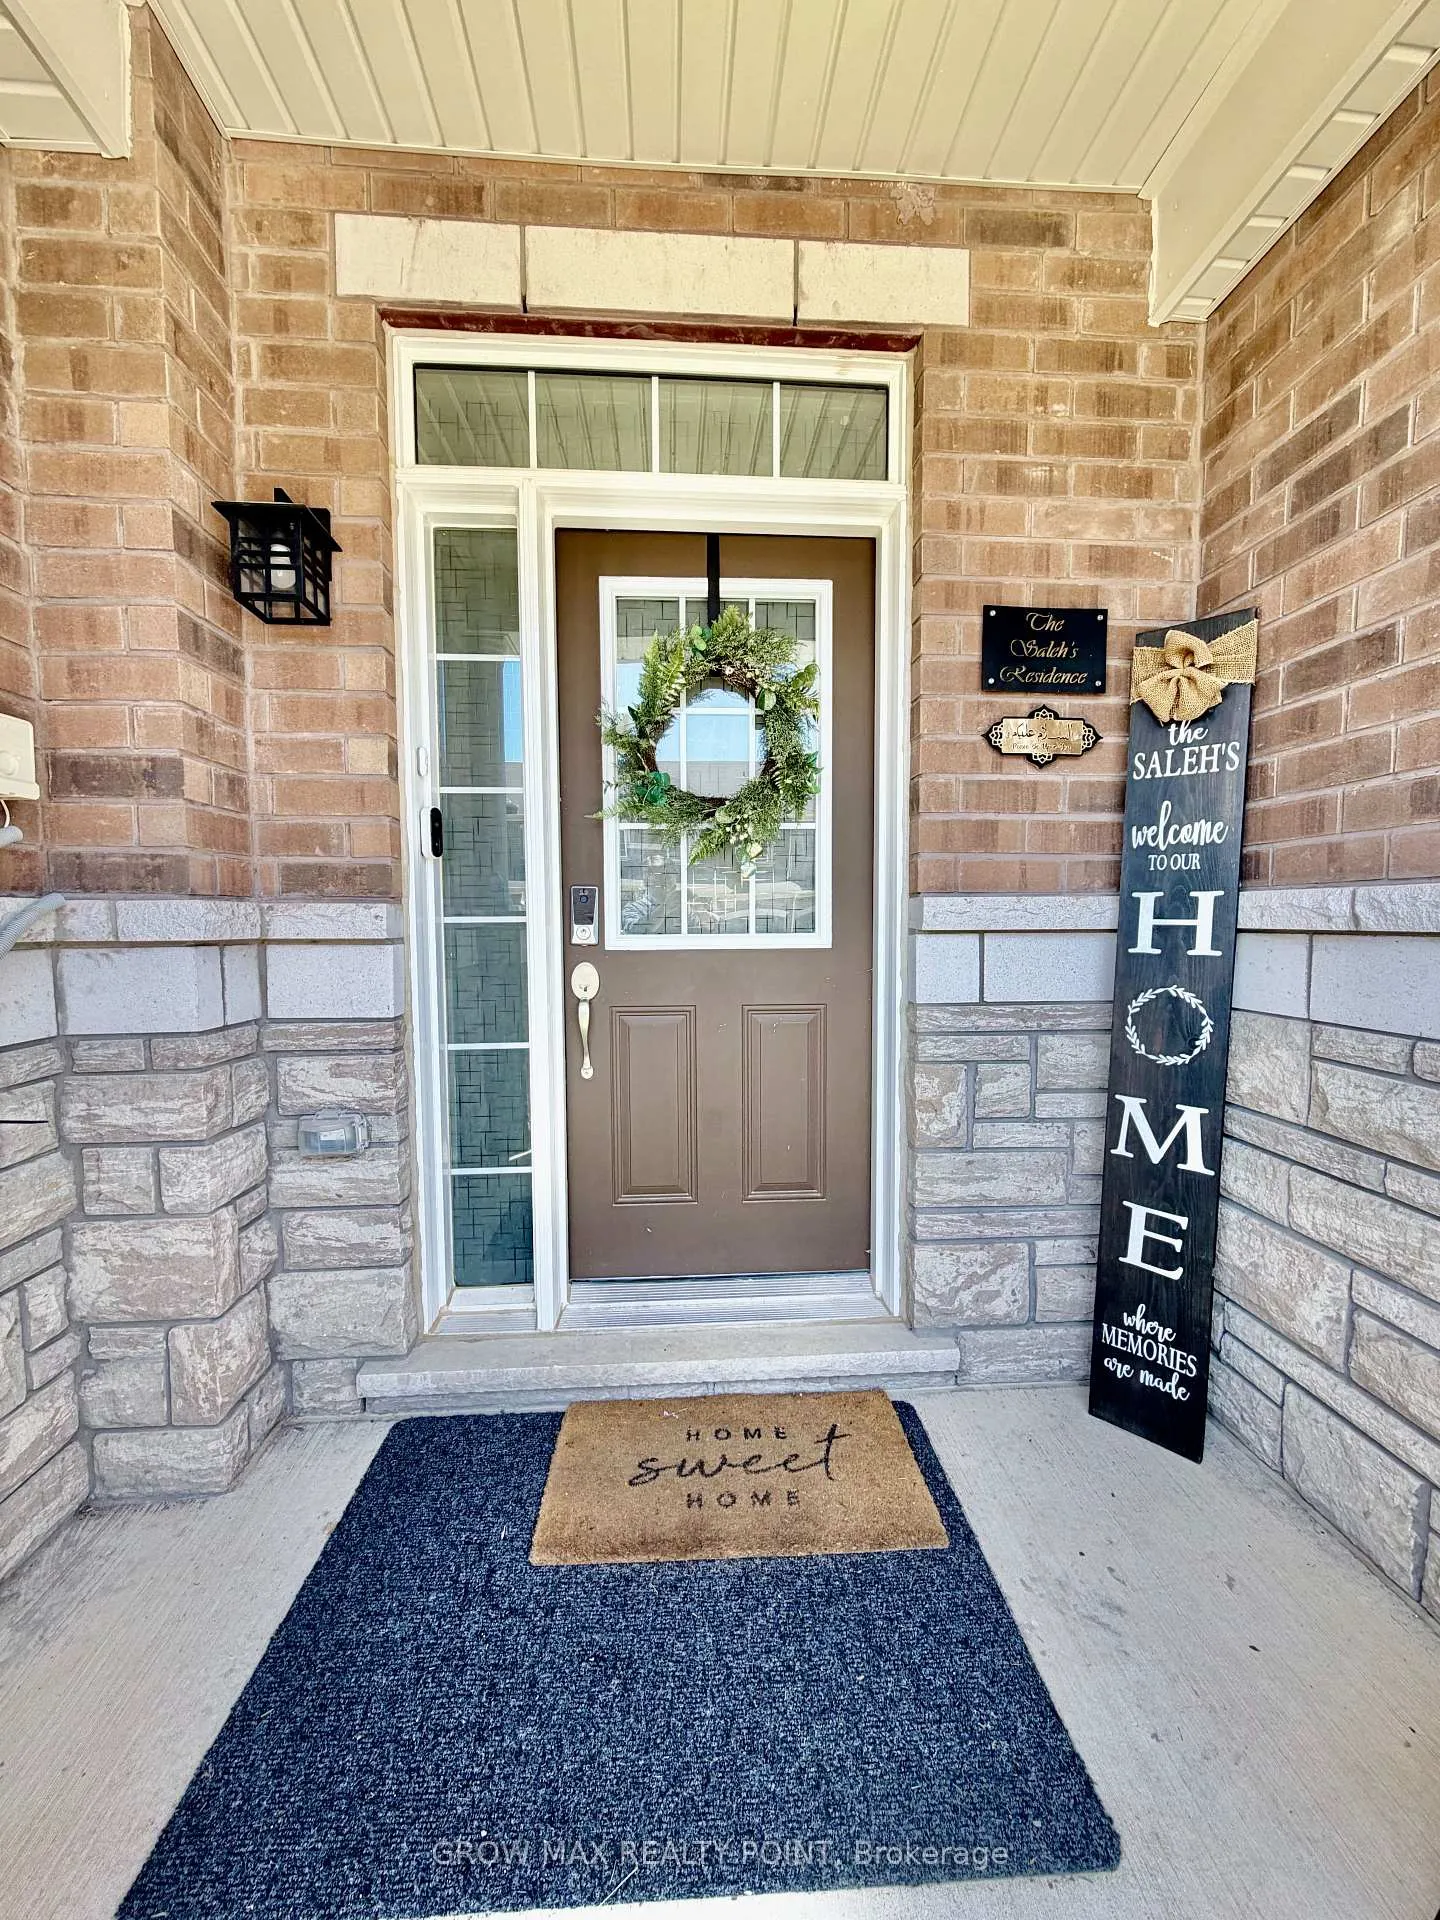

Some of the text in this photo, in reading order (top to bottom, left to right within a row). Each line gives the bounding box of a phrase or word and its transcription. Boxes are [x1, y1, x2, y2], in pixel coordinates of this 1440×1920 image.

[1026, 612, 1065, 632] The
[1010, 639, 1079, 659] Saleh's
[1000, 665, 1088, 684] Residence
[1168, 720, 1208, 746] the
[1133, 741, 1240, 780] SALEH'S
[1131, 800, 1228, 851] welcome
[1148, 853, 1201, 871] TO OUR
[1123, 1303, 1176, 1343] where
[1101, 1322, 1198, 1378] MEMORIES
[1103, 1357, 1191, 1401] are made
[686, 1425, 788, 1442] HOME
[628, 1422, 851, 1488] sweet
[686, 1490, 802, 1510] HOME
